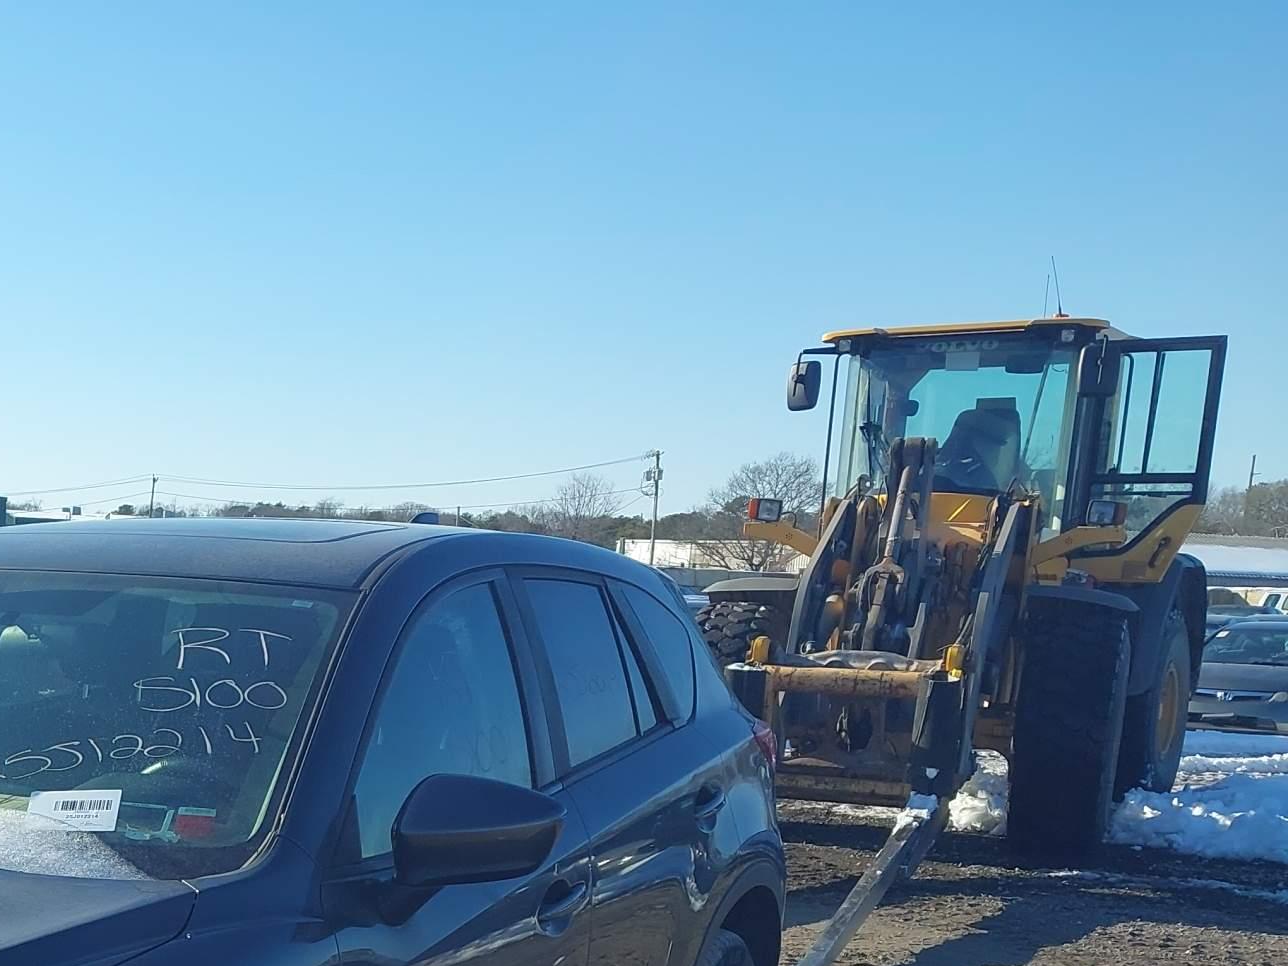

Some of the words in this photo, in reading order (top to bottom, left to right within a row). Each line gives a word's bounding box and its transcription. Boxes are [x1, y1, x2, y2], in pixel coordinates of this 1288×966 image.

[916, 340, 1000, 353] VOLVO
[171, 626, 293, 670] RT
[133, 676, 288, 712] 5100
